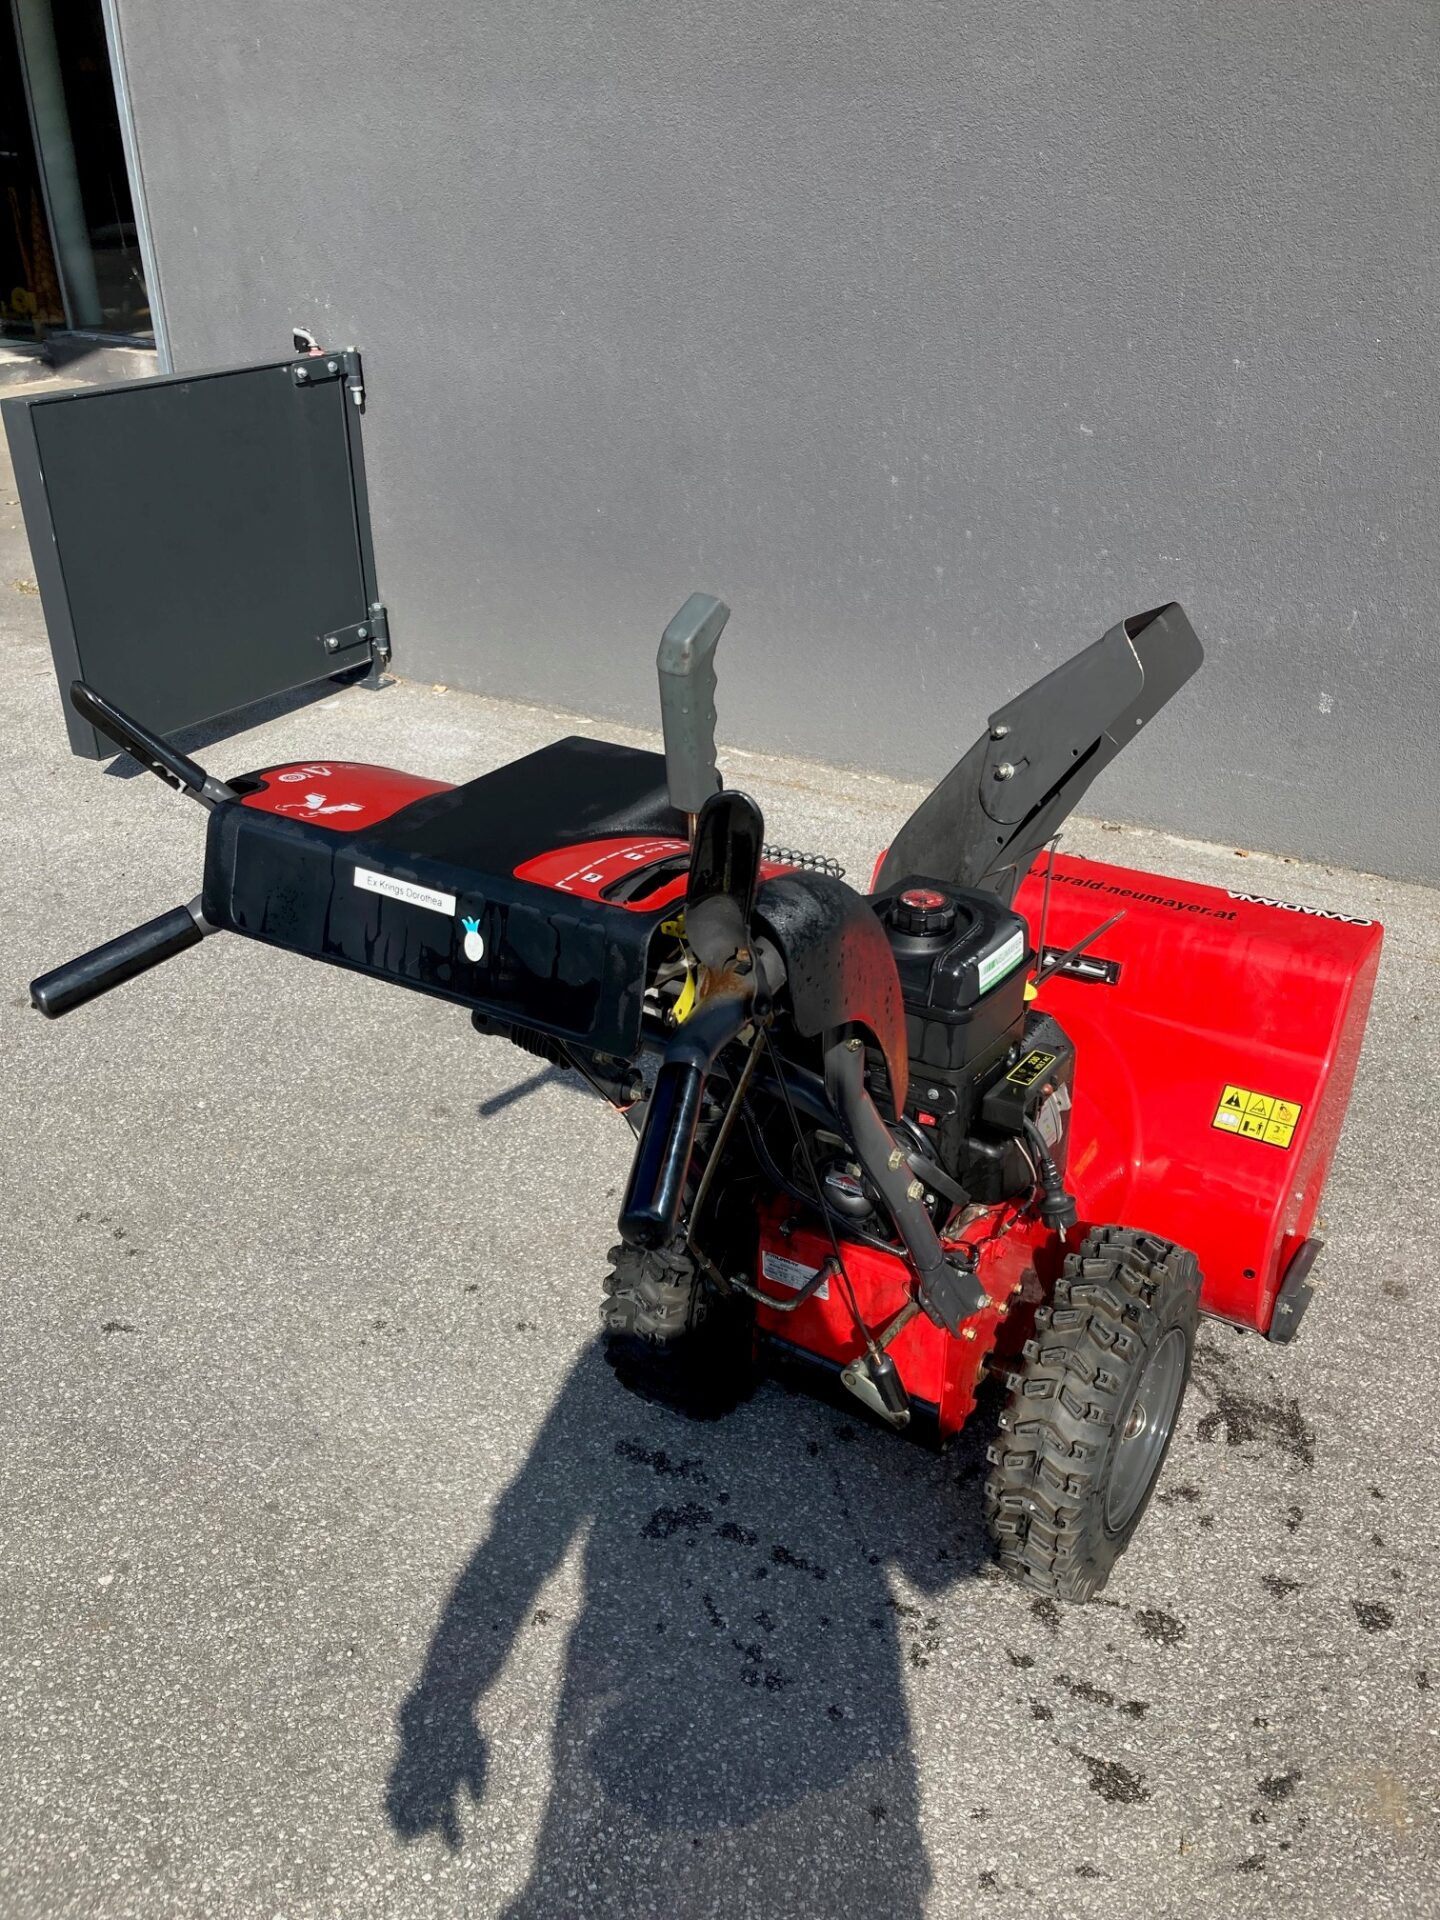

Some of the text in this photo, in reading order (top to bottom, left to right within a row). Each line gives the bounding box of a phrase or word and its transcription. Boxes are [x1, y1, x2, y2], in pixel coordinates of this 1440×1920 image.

[367, 876, 442, 907] Ex Krings Dorothea
[1226, 890, 1373, 927] CANADIANA
